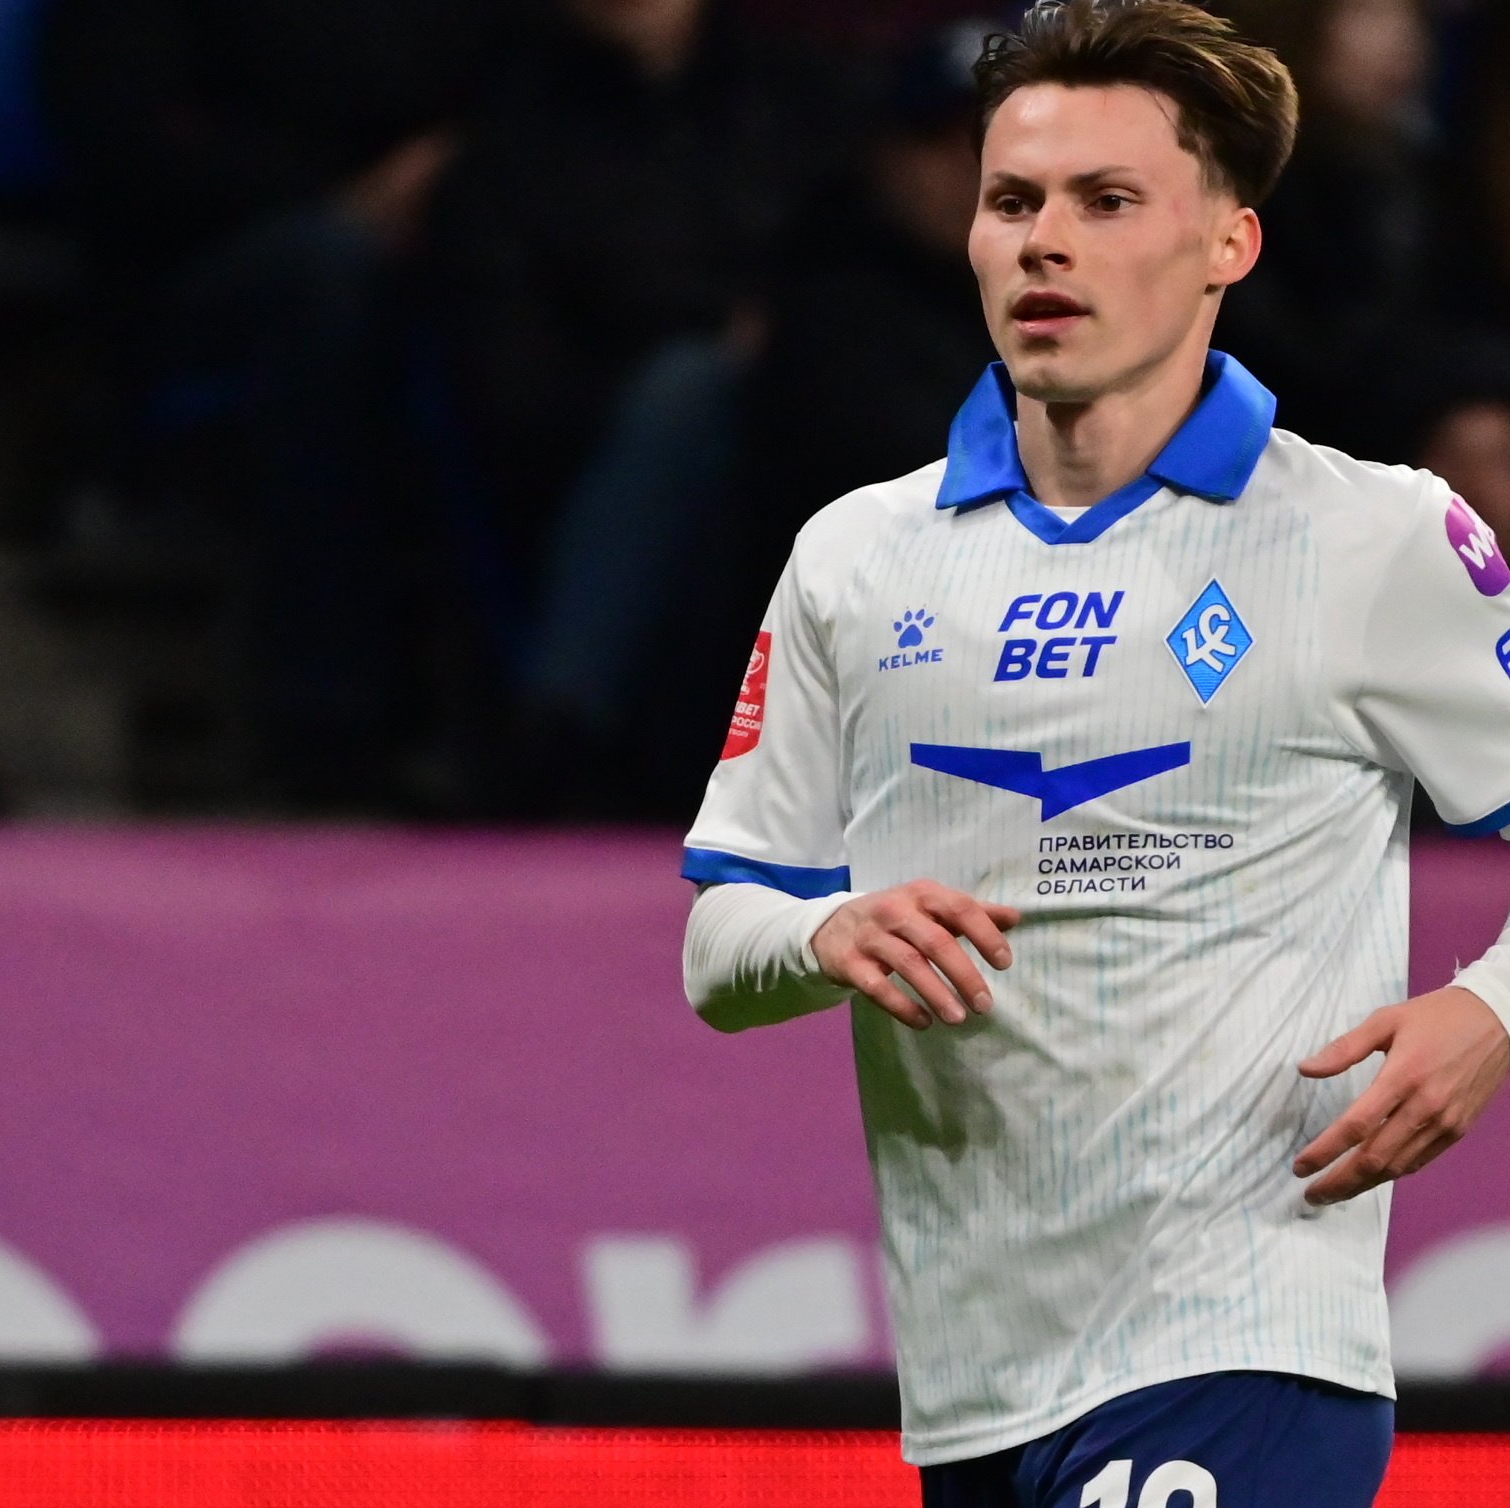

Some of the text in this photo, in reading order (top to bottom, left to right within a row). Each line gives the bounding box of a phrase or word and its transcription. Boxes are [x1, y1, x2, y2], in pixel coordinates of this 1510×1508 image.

[997, 590, 1126, 633] FON
[878, 648, 944, 672] KELME
[993, 635, 1118, 683] BET
[1039, 833, 1235, 853] ПРАВИТЕЛЬСТВО
[1038, 852, 1182, 875] САМАРСКОЙ
[1036, 876, 1147, 896] ОБЛАСТИ
